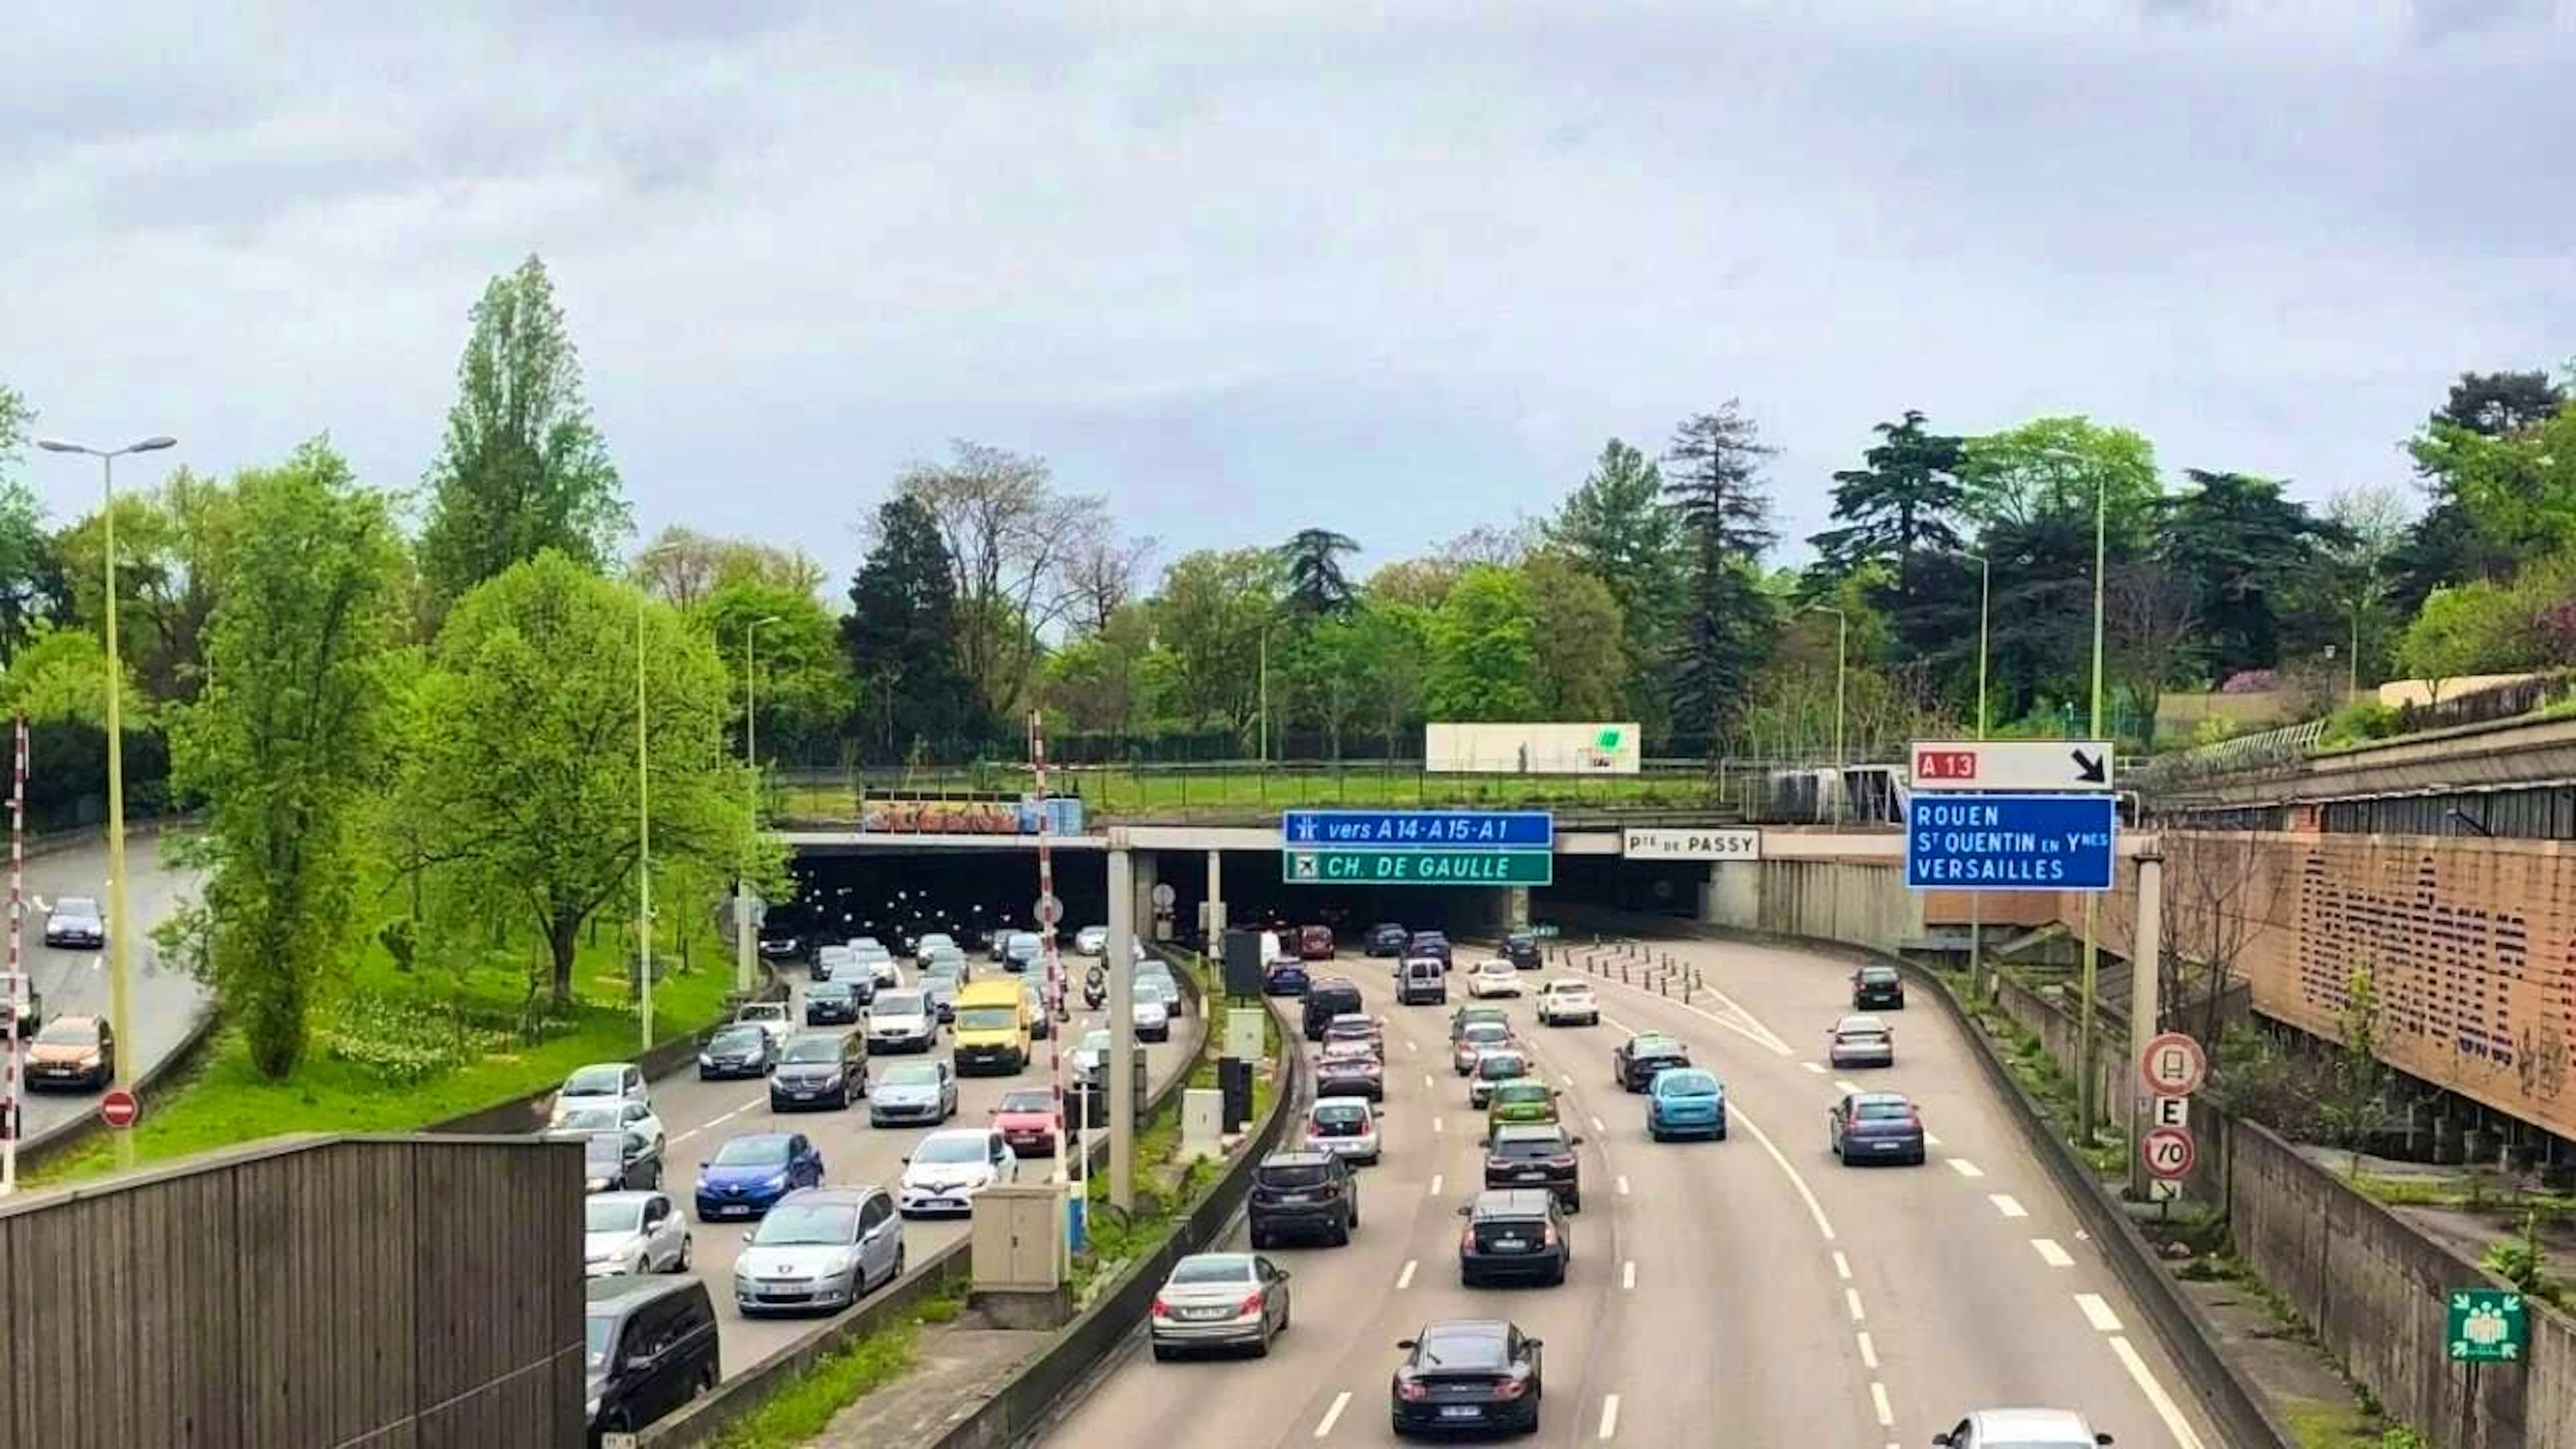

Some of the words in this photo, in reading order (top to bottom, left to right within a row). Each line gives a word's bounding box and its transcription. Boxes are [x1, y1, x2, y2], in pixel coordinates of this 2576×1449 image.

[1917, 806, 1998, 826] ROUEN
[1329, 822, 1371, 839] vers
[1689, 837, 1753, 852] PASSY
[1945, 833, 2036, 854] QUENTIN
[1377, 857, 1407, 877] DE
[1418, 856, 1511, 877] GAULLE
[1917, 859, 2064, 879] VERSAILLES
[2163, 1099, 2180, 1124] E
